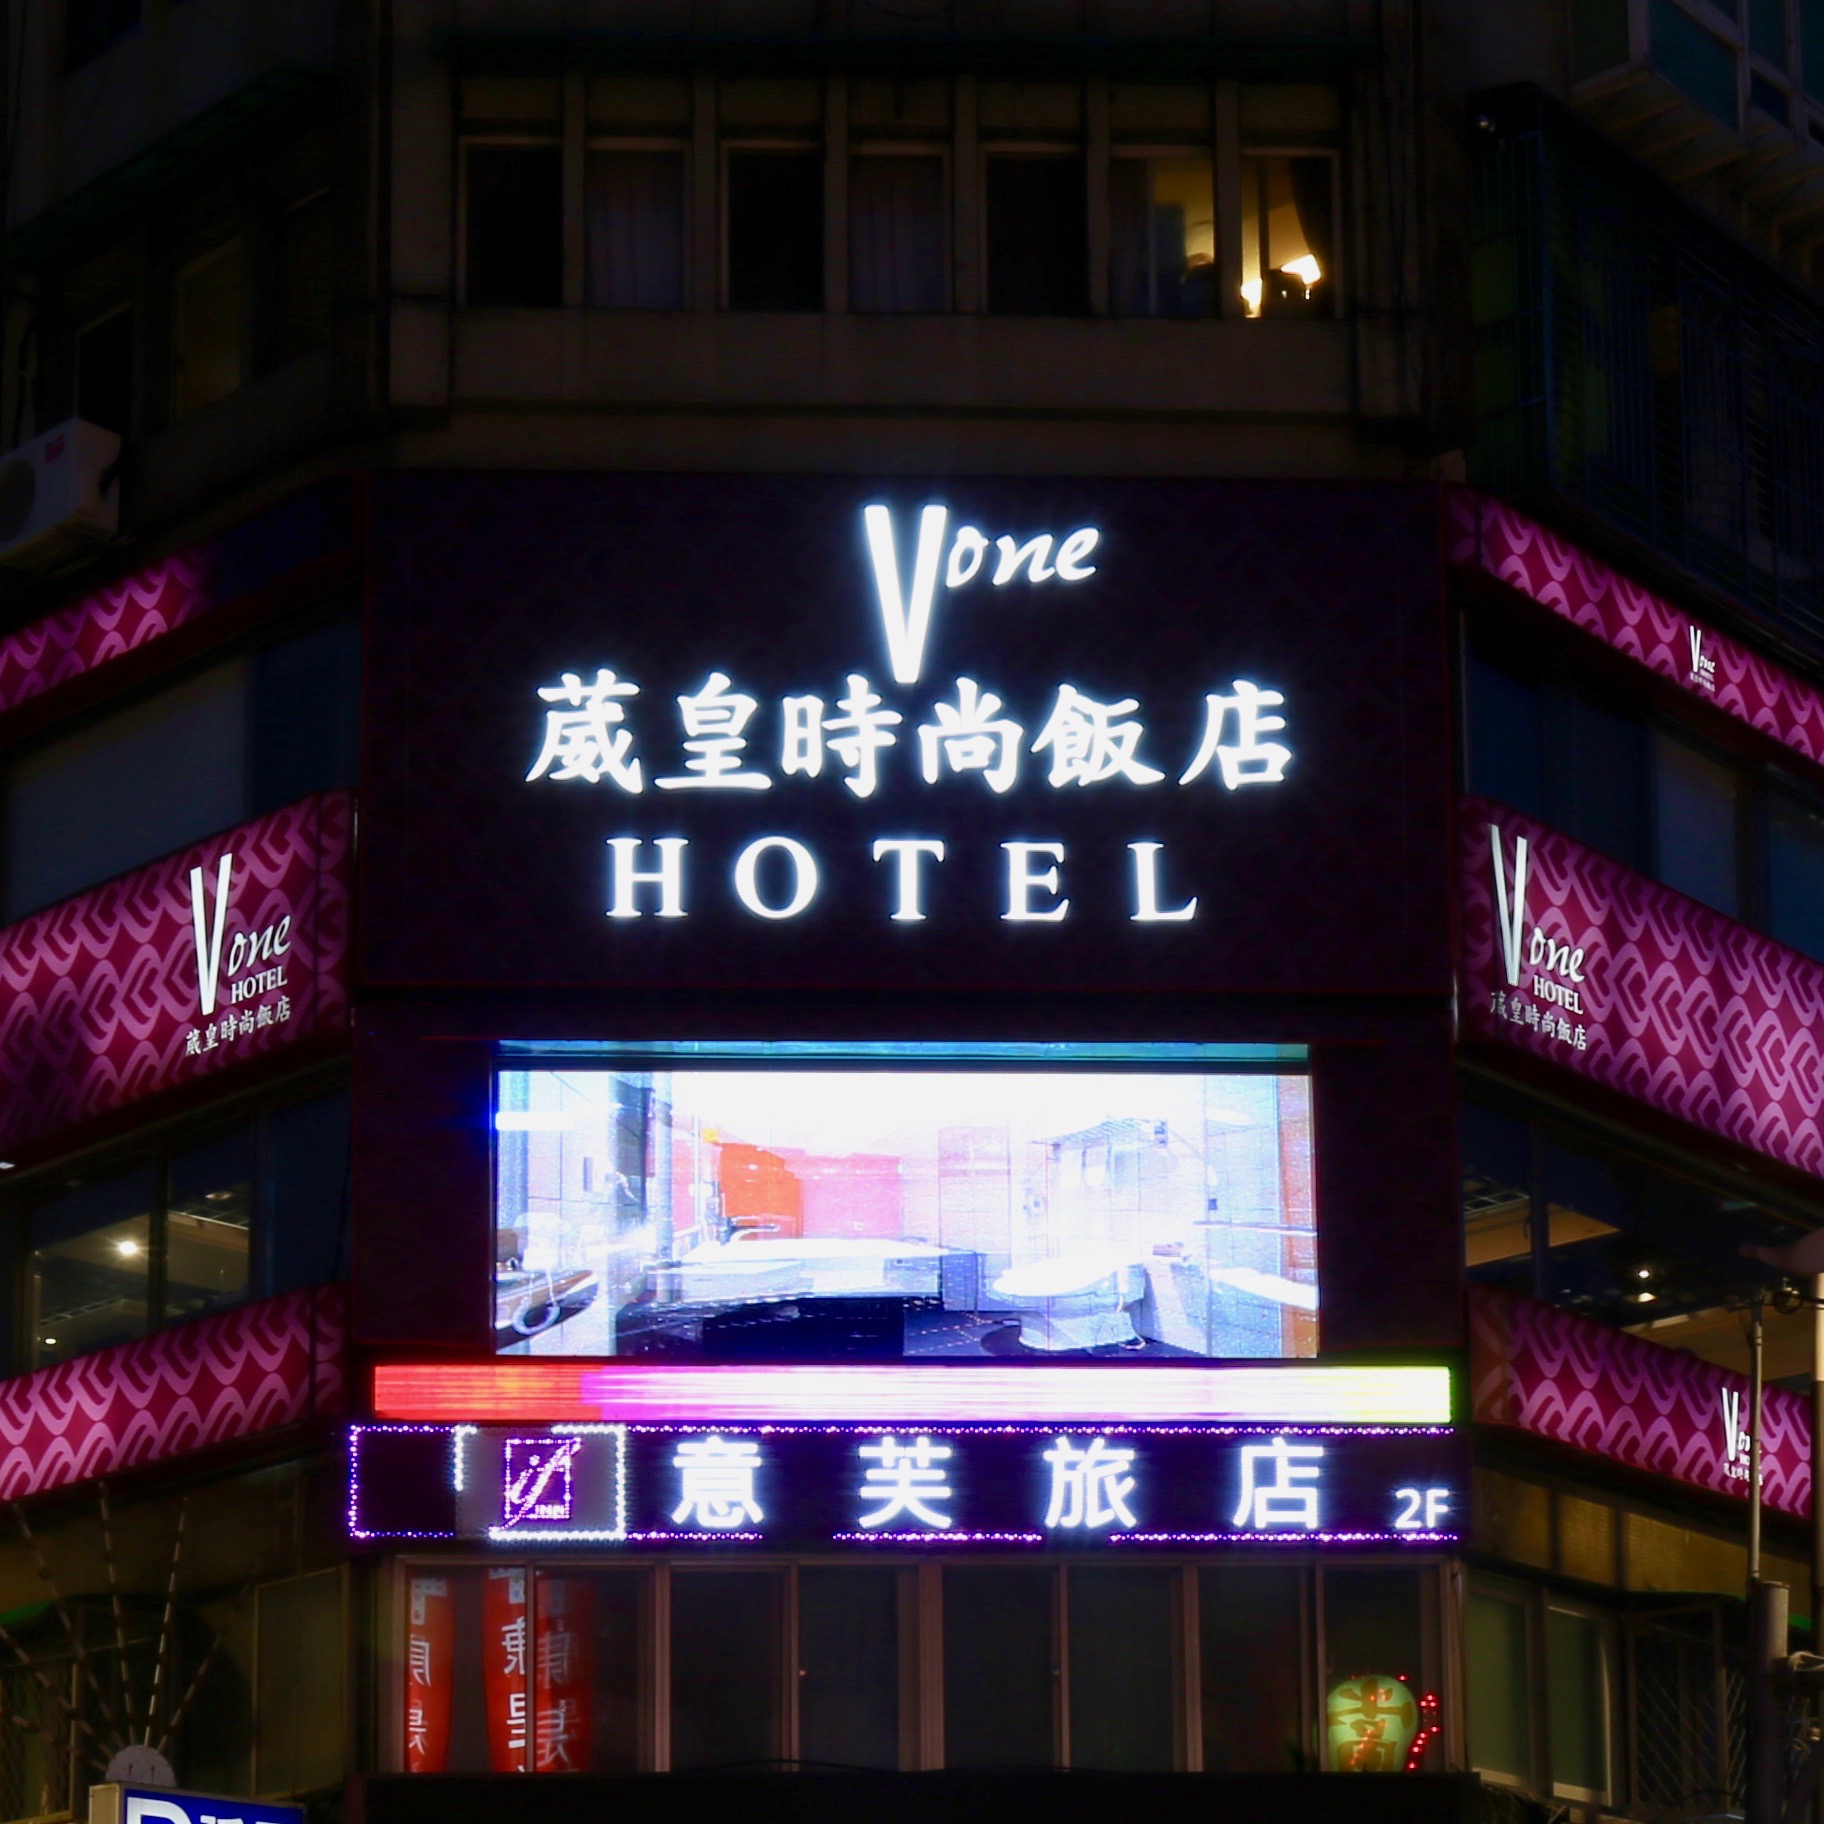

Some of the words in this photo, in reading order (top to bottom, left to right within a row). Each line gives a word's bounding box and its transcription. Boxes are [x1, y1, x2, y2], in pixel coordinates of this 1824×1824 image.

[605, 836, 1197, 921] HOTEL
[231, 965, 289, 1004] HOTEL
[1532, 975, 1584, 1015] HOTEL
[672, 1436, 1324, 1531] 意芙旅店
[1394, 1488, 1452, 1529] 2F
